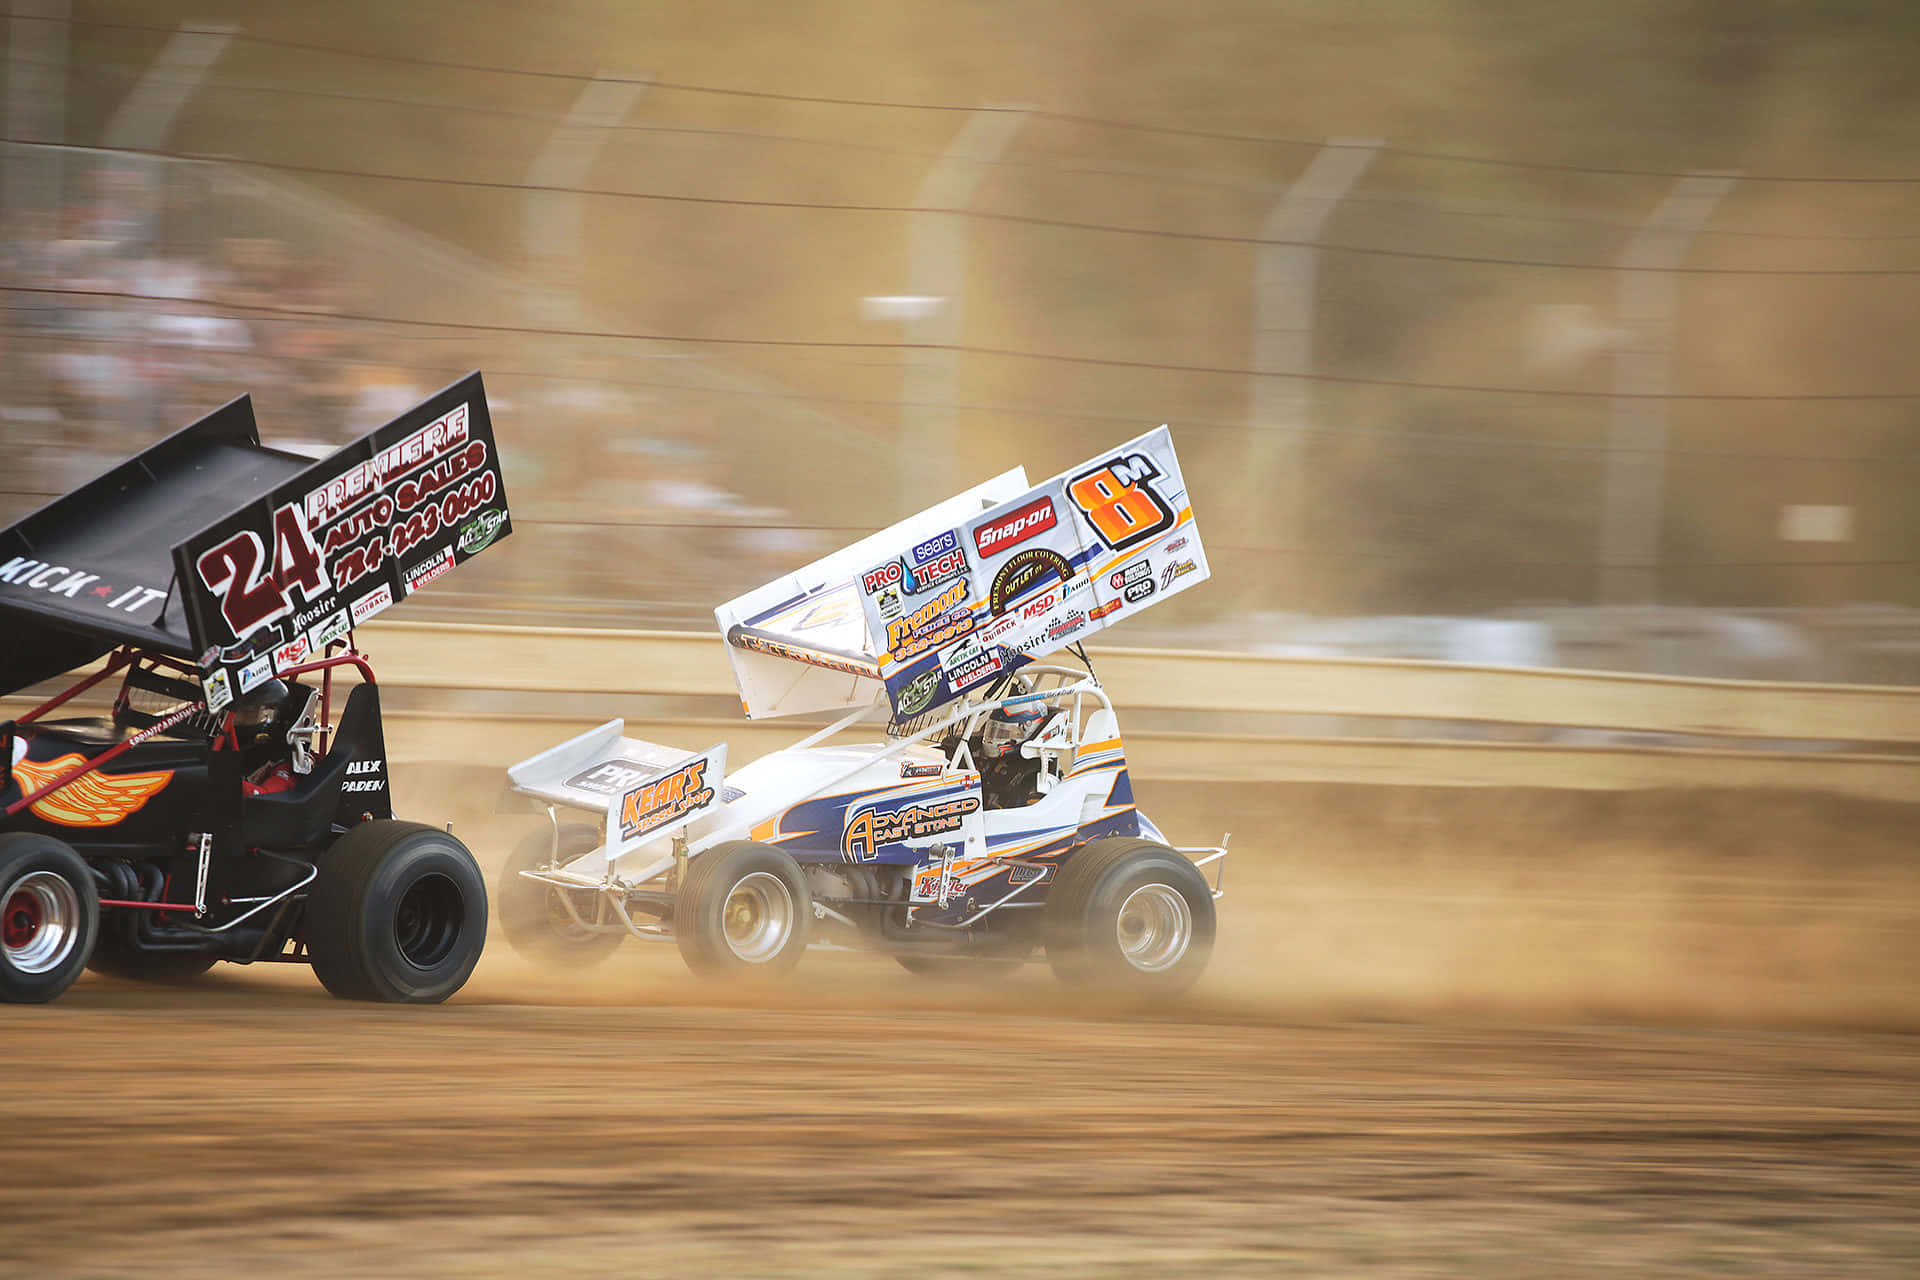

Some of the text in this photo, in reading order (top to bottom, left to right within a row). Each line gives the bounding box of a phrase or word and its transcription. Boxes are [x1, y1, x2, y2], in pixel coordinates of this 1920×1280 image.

[306, 404, 468, 532] PREMIERE
[324, 440, 486, 554] AUTO SALES
[978, 505, 1052, 550] Snap-on
[916, 533, 954, 560] sears
[0, 556, 168, 613] KICK IT
[197, 502, 332, 640] 24
[405, 552, 450, 587] LINCOLN WELDERS
[865, 551, 965, 592] PRO TECH
[1005, 567, 1034, 595] OUTLET
[354, 592, 390, 617] OUTBACK
[1126, 581, 1151, 598] PRO
[887, 578, 968, 652] Fremont
[1023, 594, 1055, 620] MSD
[982, 619, 1017, 643] OUTBACK
[277, 637, 306, 665] MSD
[948, 653, 997, 685] LINCOLN WELDERS
[345, 760, 381, 775] ALEX
[341, 780, 386, 793] PADEN
[622, 762, 705, 826] KEAR'S
[846, 799, 978, 858] ADVANCED
[873, 815, 961, 842] CAST STONE
